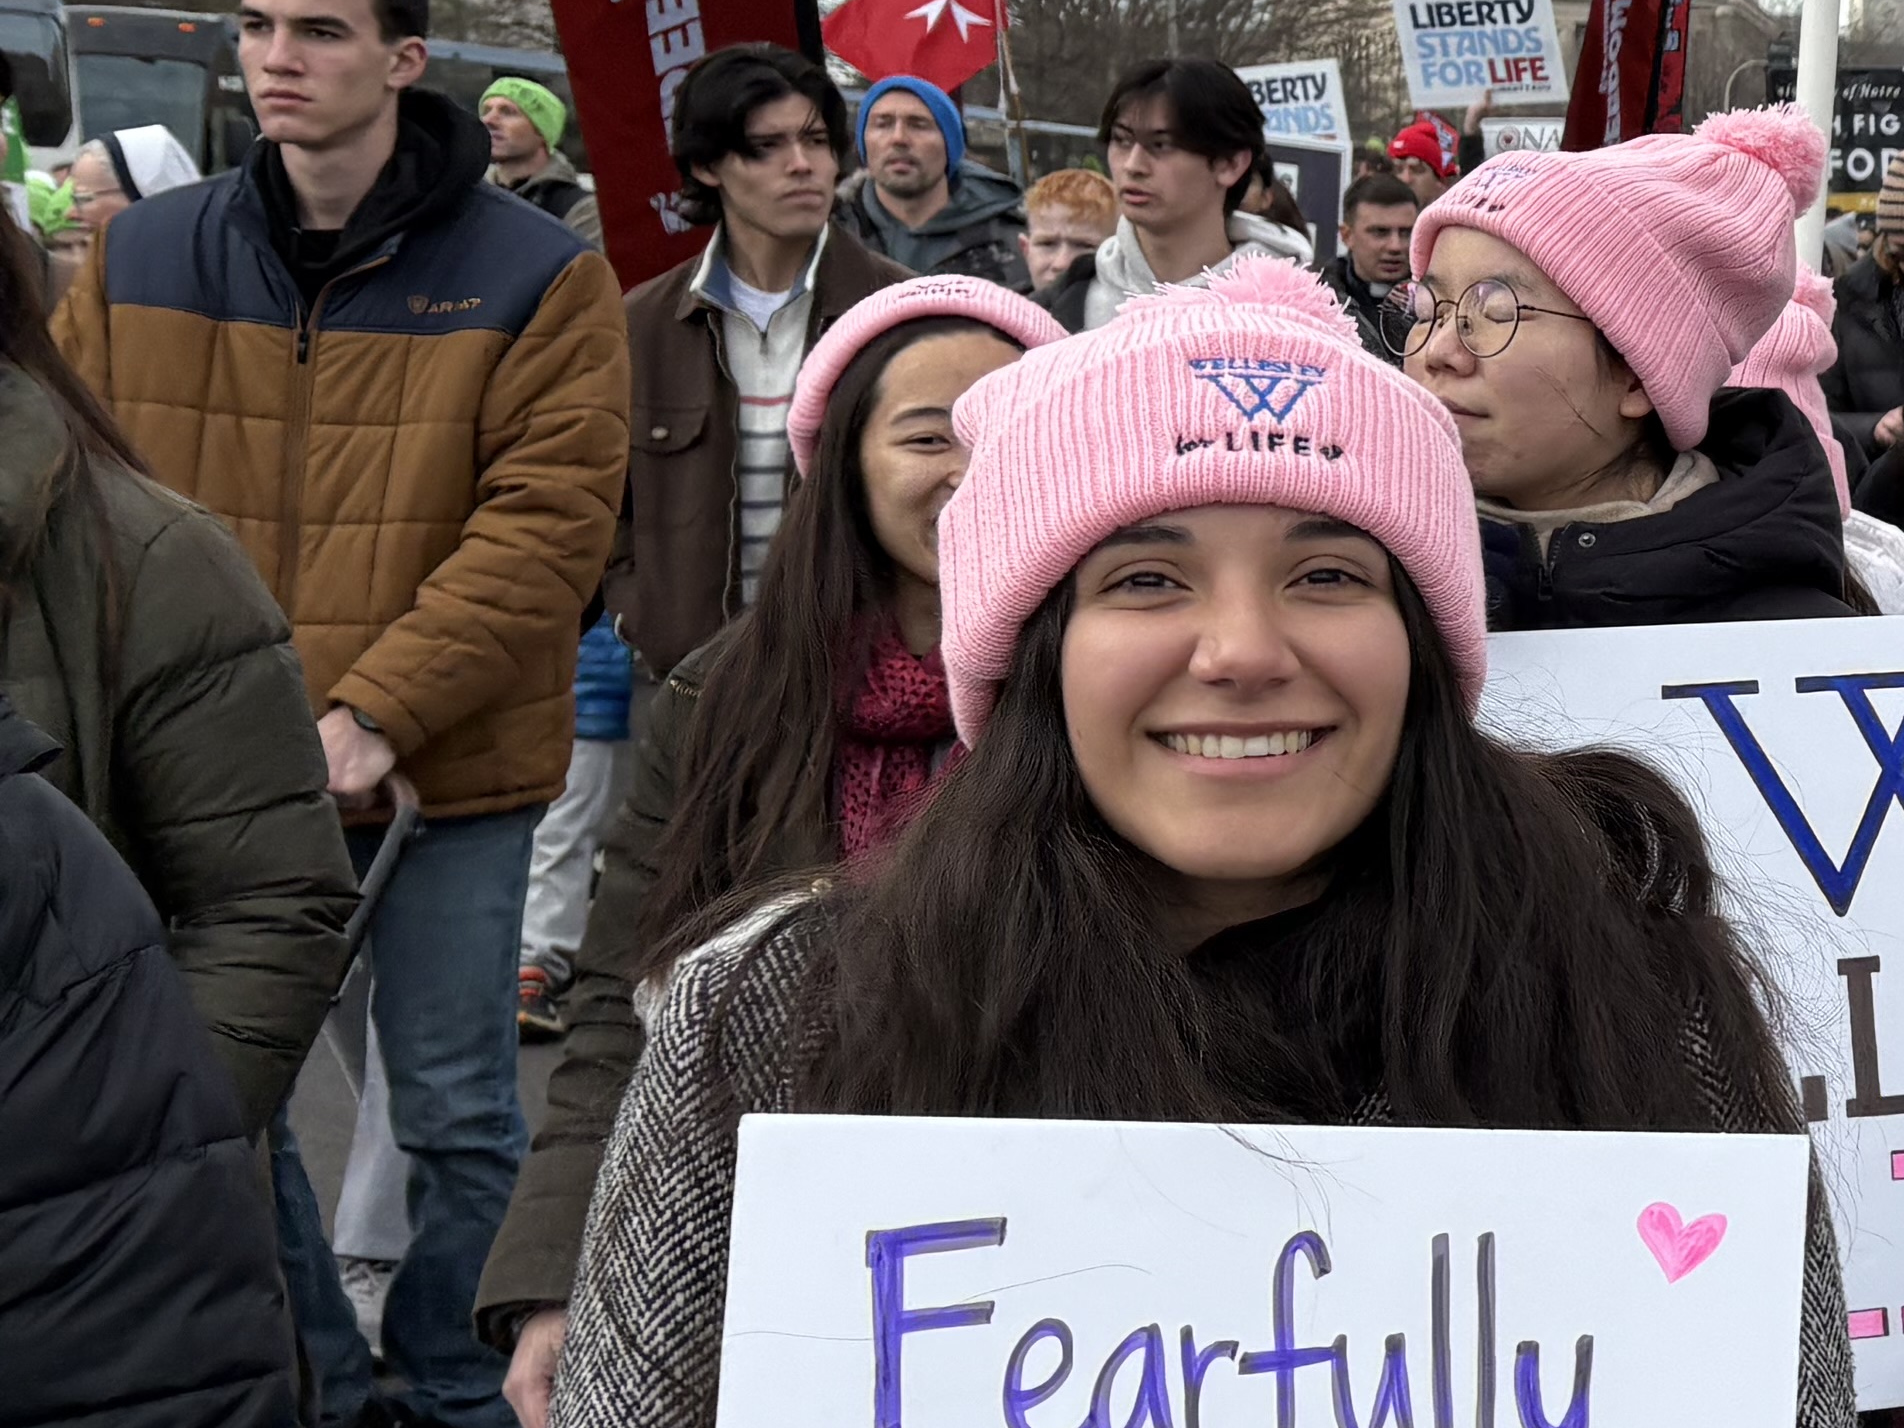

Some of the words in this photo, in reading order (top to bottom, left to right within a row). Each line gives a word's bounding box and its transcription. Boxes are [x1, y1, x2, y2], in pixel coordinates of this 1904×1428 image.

[1415, 26, 1544, 60] STANDS
[1247, 72, 1327, 105] BERTY
[1421, 57, 1487, 89] FOR
[1488, 56, 1550, 85] LIFE
[1859, 83, 1902, 100] Notre
[1264, 102, 1336, 135] ANDS
[1194, 374, 1326, 425] W
[1175, 432, 1216, 457] for
[1225, 431, 1312, 457] LIFE
